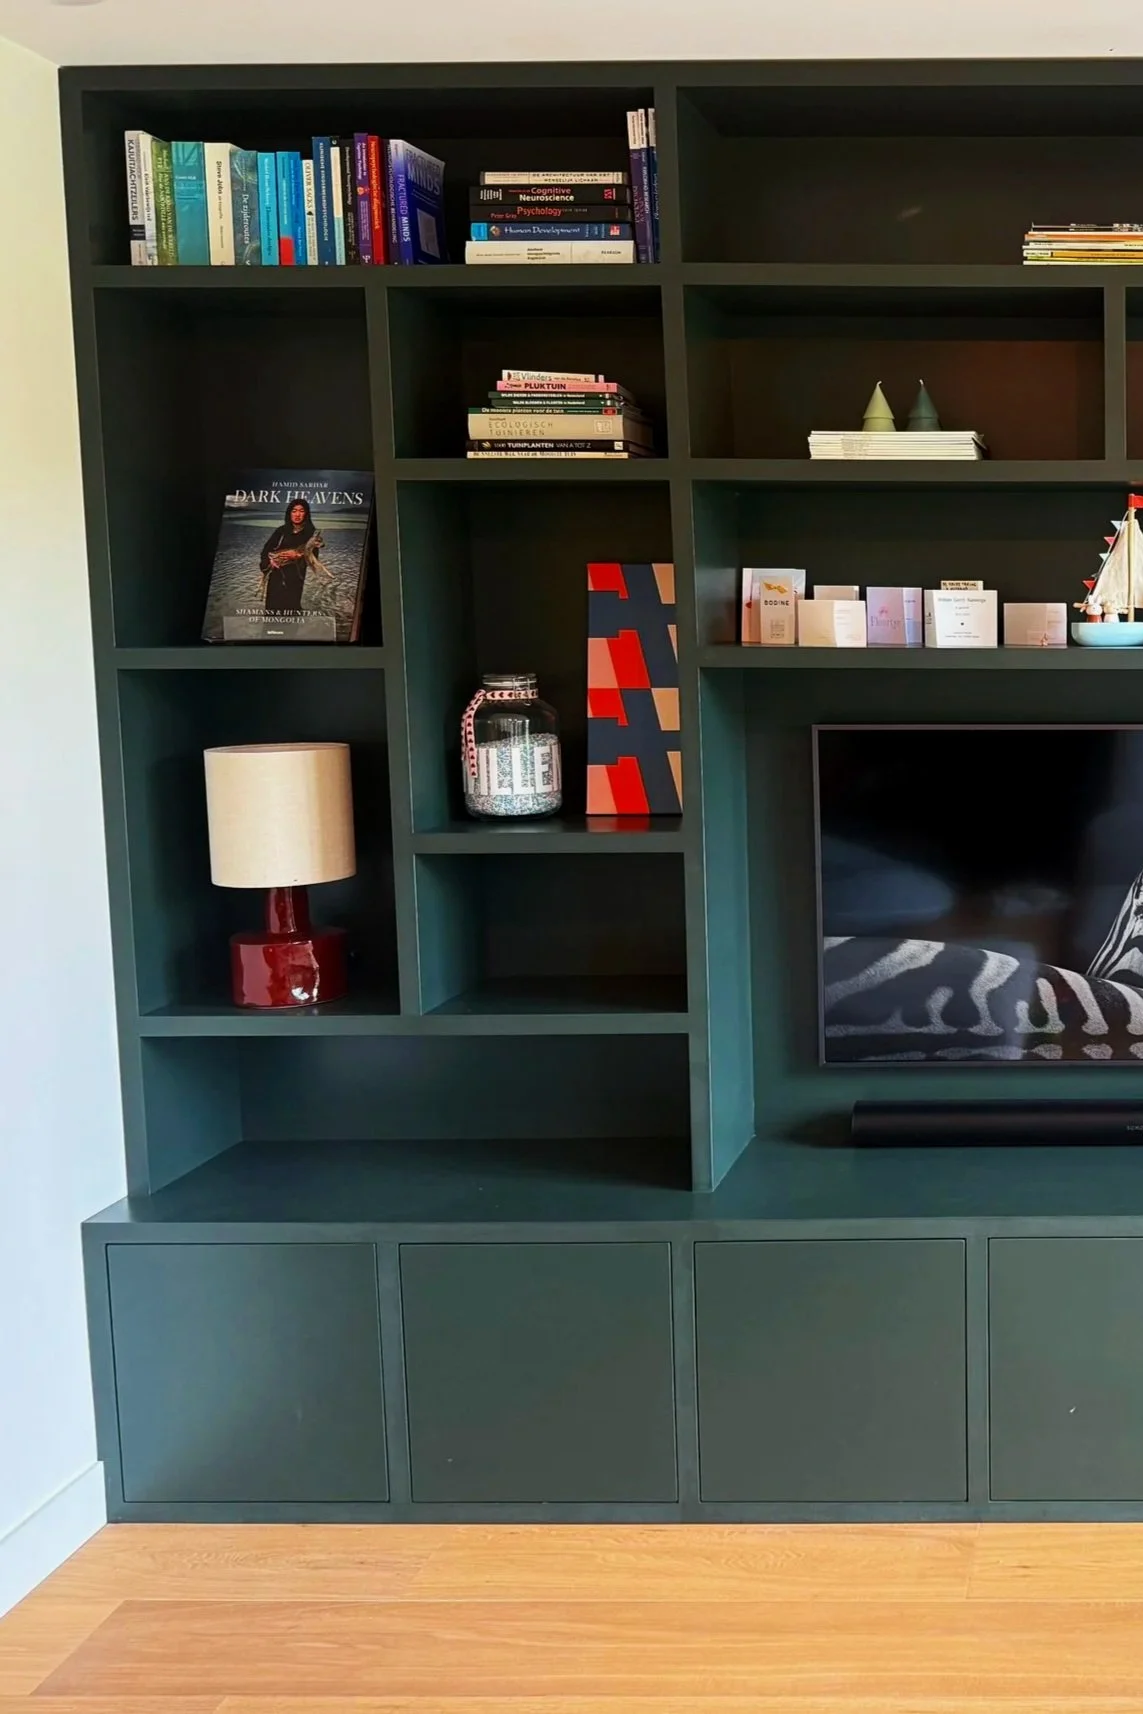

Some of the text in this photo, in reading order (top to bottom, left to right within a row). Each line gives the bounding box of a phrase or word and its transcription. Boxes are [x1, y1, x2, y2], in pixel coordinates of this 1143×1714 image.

[531, 187, 572, 196] Cognitive
[242, 194, 249, 203] De
[519, 194, 575, 202] Neuroscience
[397, 174, 411, 242] FRACTURED MINDS
[517, 206, 562, 217] Psychology
[241, 205, 251, 245] zijderoutes
[504, 226, 581, 236] Human Development
[521, 372, 552, 382] Vlinders
[524, 382, 566, 390] PLUKTUIN
[488, 420, 553, 429] ECOLOGISCH
[234, 489, 363, 506] DARK HEAVENS
[236, 608, 322, 617] SHAMANS & HUNTERS
[248, 616, 305, 624] OF MONGOLIA
